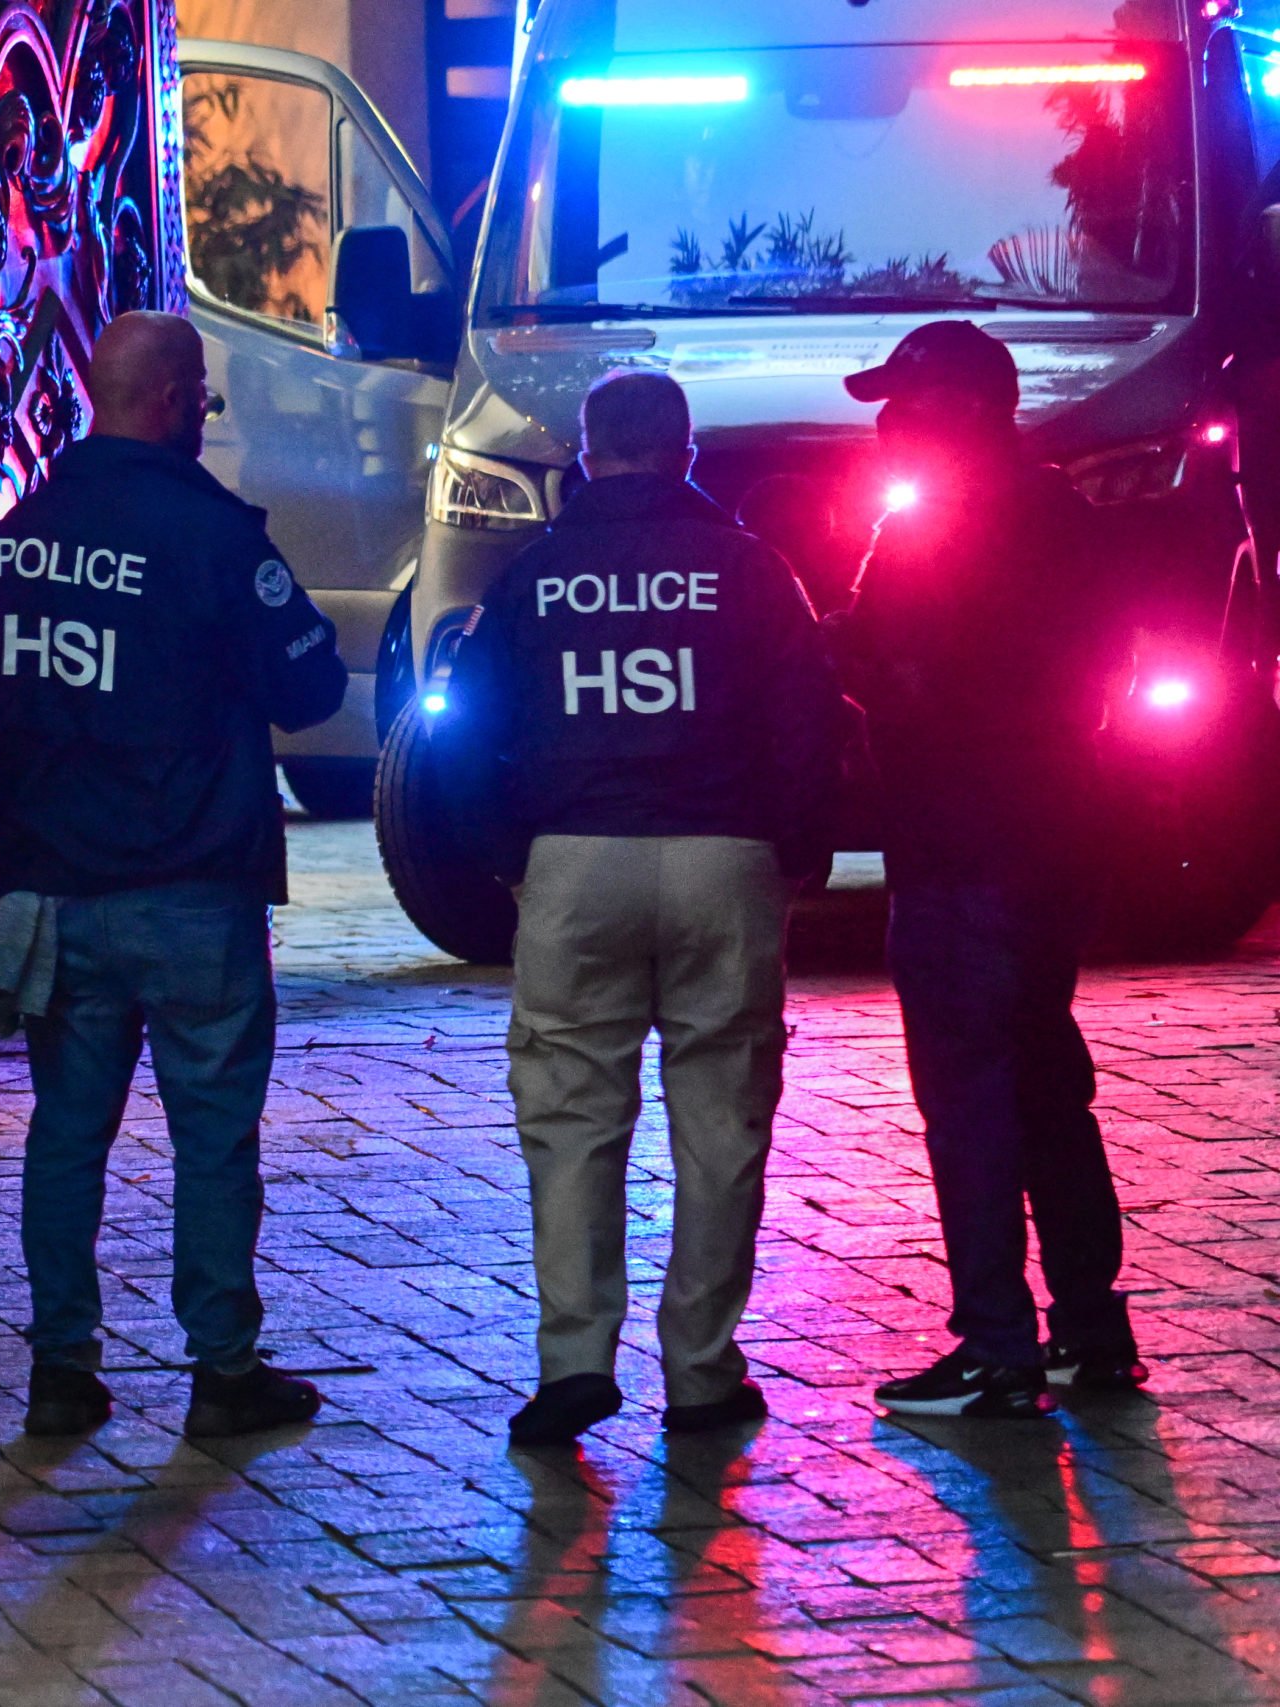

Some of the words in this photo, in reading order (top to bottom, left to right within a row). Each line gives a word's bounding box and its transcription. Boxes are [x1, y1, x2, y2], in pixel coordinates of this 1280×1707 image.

[536, 570, 719, 617] POLICE
[2, 613, 116, 692] HSI
[285, 624, 326, 660] MIAMI
[561, 647, 696, 715] HSI
